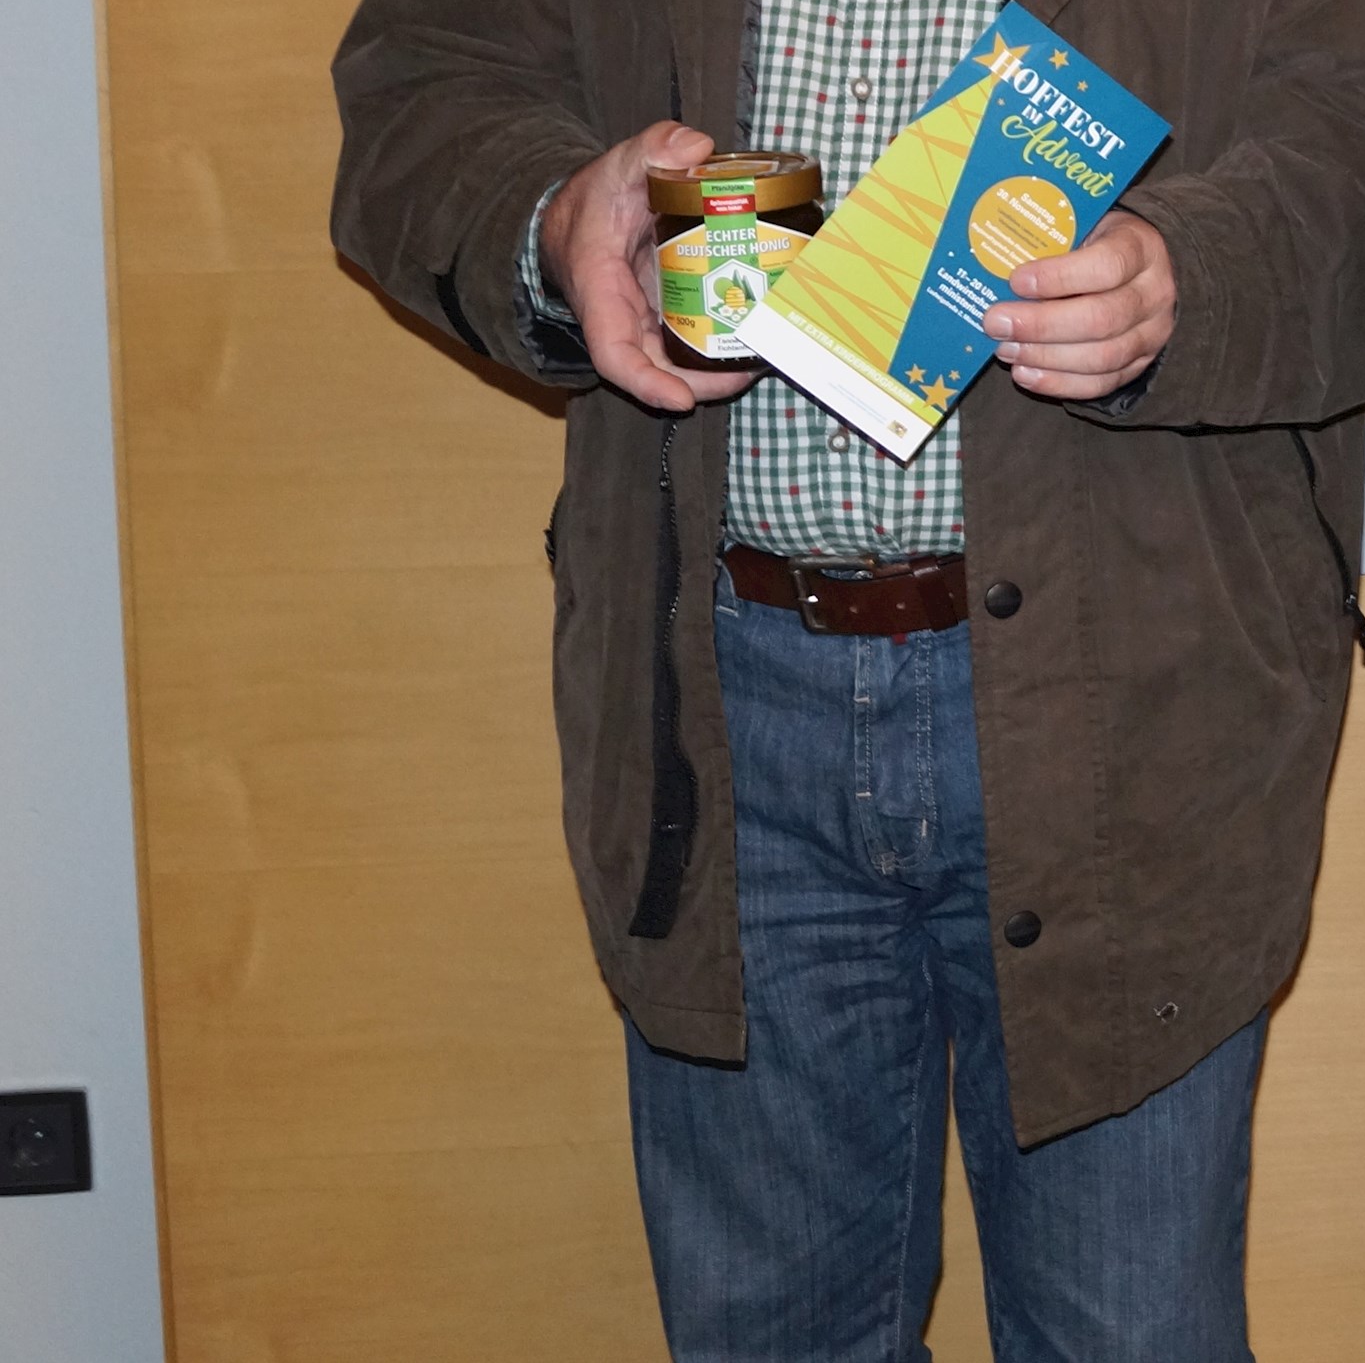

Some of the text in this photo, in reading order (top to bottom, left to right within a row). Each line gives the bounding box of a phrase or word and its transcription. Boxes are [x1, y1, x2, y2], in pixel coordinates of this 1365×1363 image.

[989, 49, 1126, 160] HOFFEST
[1021, 103, 1044, 125] IM
[1001, 115, 1115, 198] Advent
[1009, 196, 1050, 233] November
[676, 237, 791, 258] DEUTSCHER HONIG
[705, 227, 757, 242] ECHTER
[937, 267, 991, 311] Landwirtscha
[980, 285, 998, 302] Uhr
[676, 316, 696, 329] 500g
[832, 344, 916, 406] KINDERPROGRAMM
